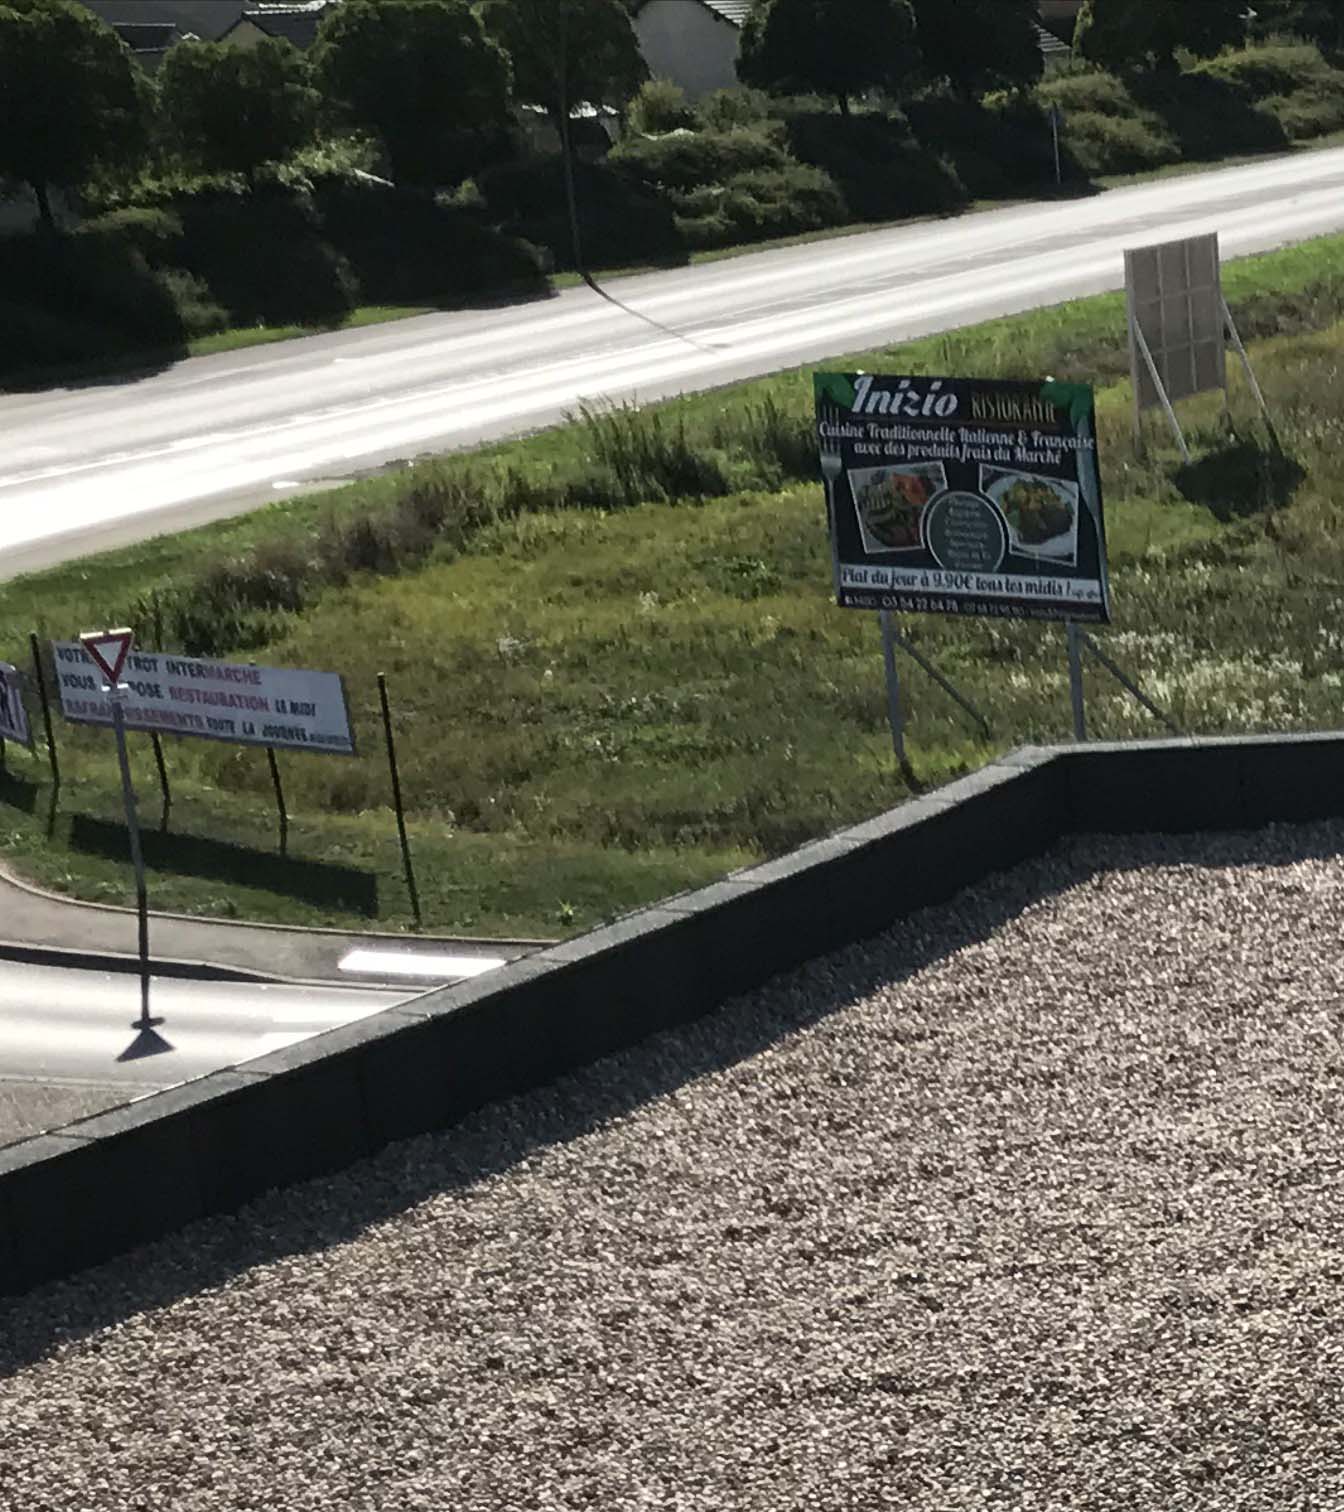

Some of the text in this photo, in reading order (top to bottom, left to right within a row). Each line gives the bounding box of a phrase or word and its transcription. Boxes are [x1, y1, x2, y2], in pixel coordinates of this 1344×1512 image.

[851, 376, 958, 416] Inizio
[819, 421, 865, 438] Cuisine
[866, 422, 956, 442] Traditionnelle
[958, 427, 1015, 445] Italienne
[1031, 430, 1095, 452] Française
[854, 443, 881, 455] avec
[884, 441, 905, 456] des
[907, 442, 960, 460] produits
[959, 443, 992, 463] frais
[993, 446, 1011, 461] du
[842, 567, 868, 583] Plat
[871, 569, 889, 585] du
[889, 568, 918, 589] jour
[975, 576, 1002, 592] tous
[1004, 576, 1023, 593] les
[1025, 578, 1063, 596] midis
[56, 647, 93, 664] VOTR
[61, 674, 97, 691] VOUS
